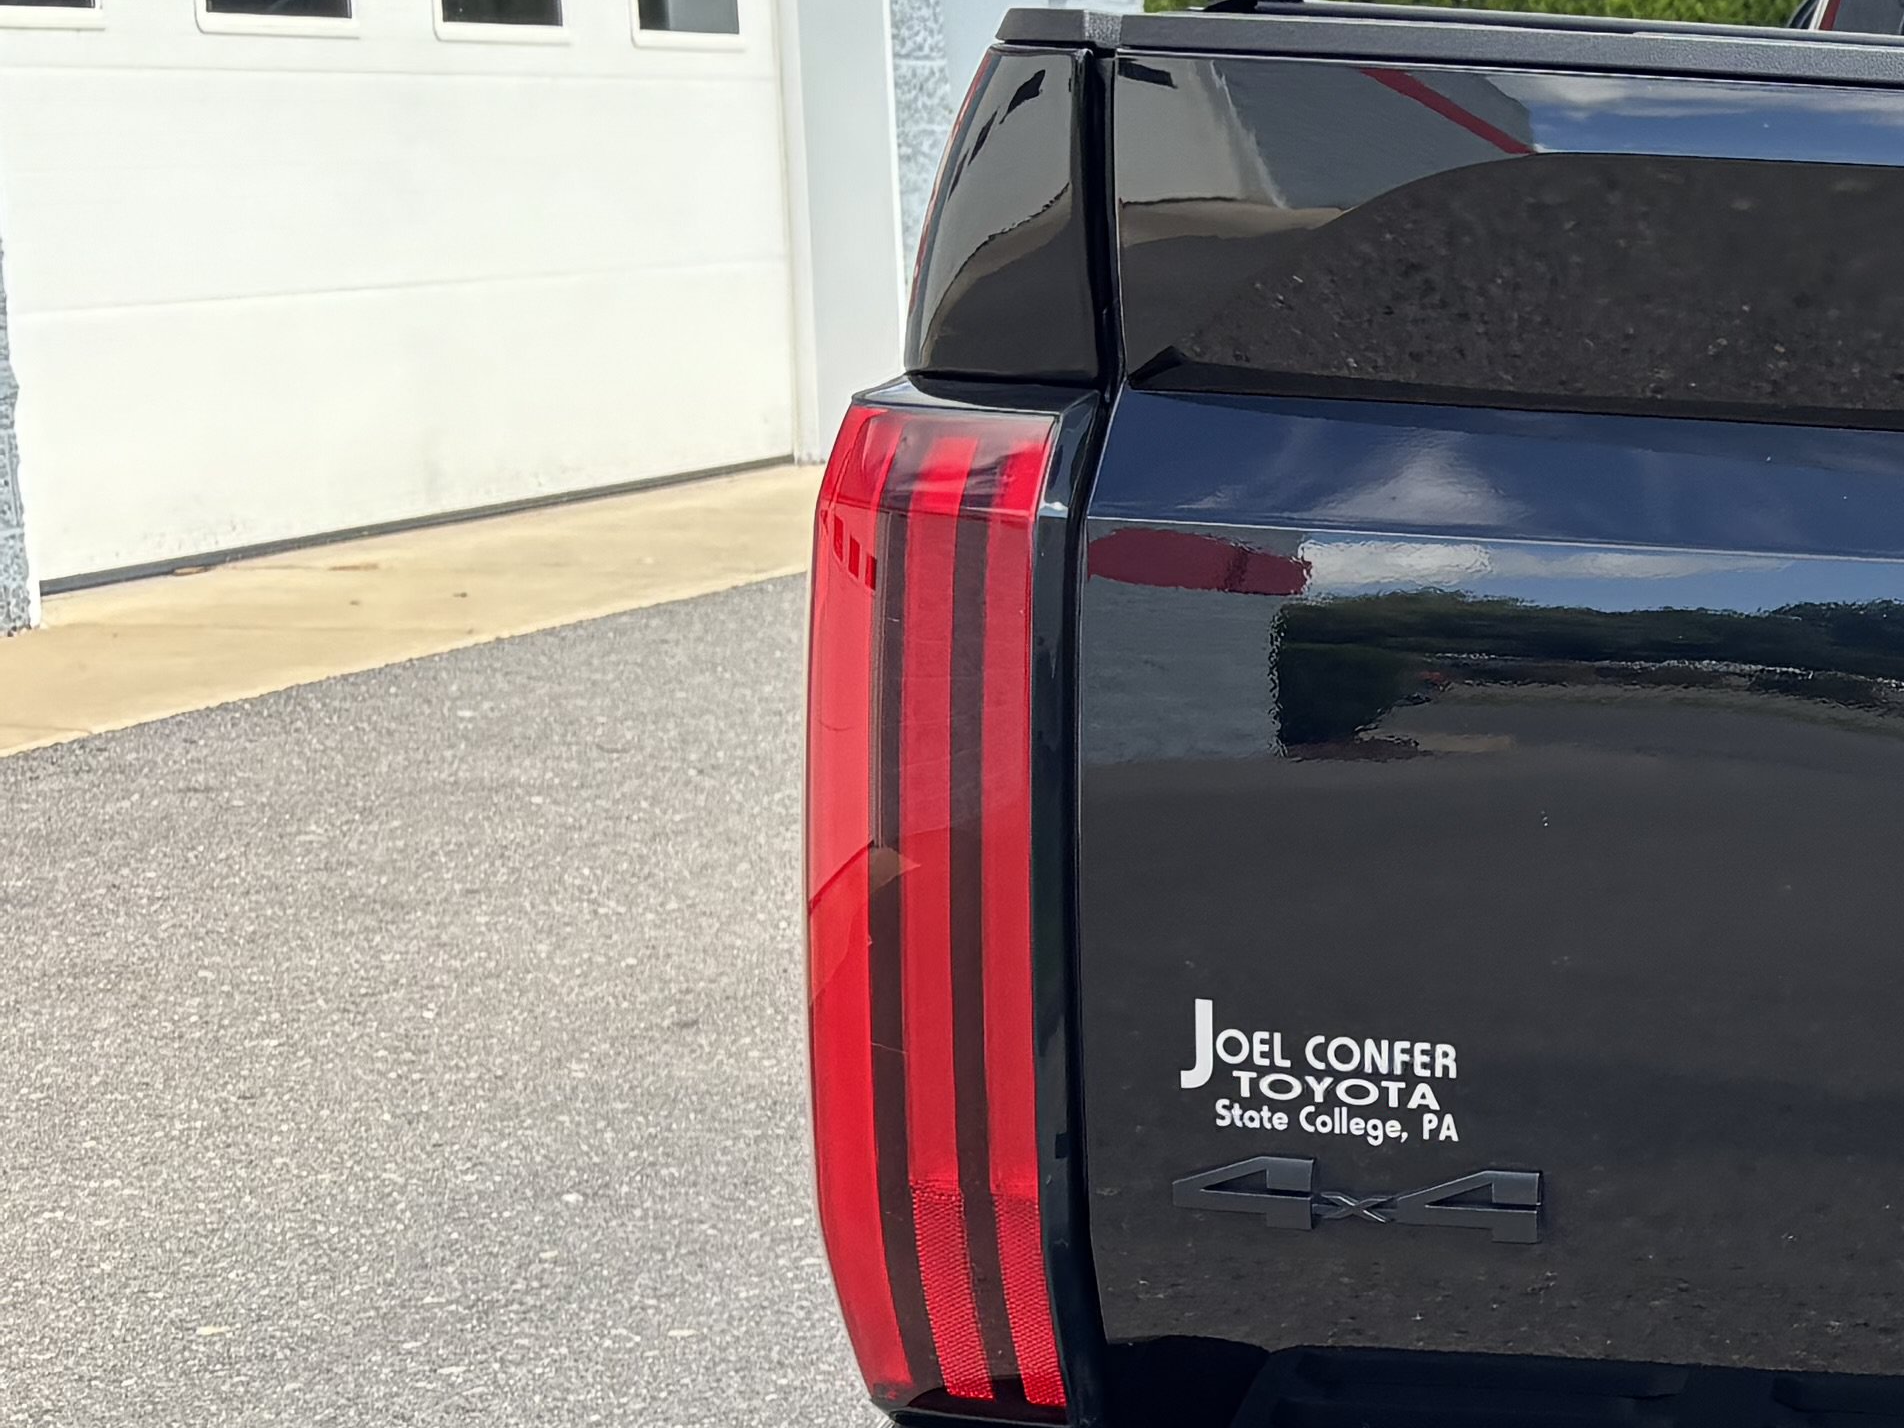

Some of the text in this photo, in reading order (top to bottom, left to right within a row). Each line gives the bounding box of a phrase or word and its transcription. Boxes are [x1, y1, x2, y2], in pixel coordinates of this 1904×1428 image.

[1180, 998, 1458, 1089] JOEL CONFER
[1232, 1070, 1441, 1111] TOYOTA
[1215, 1098, 1460, 1146] State College, PA
